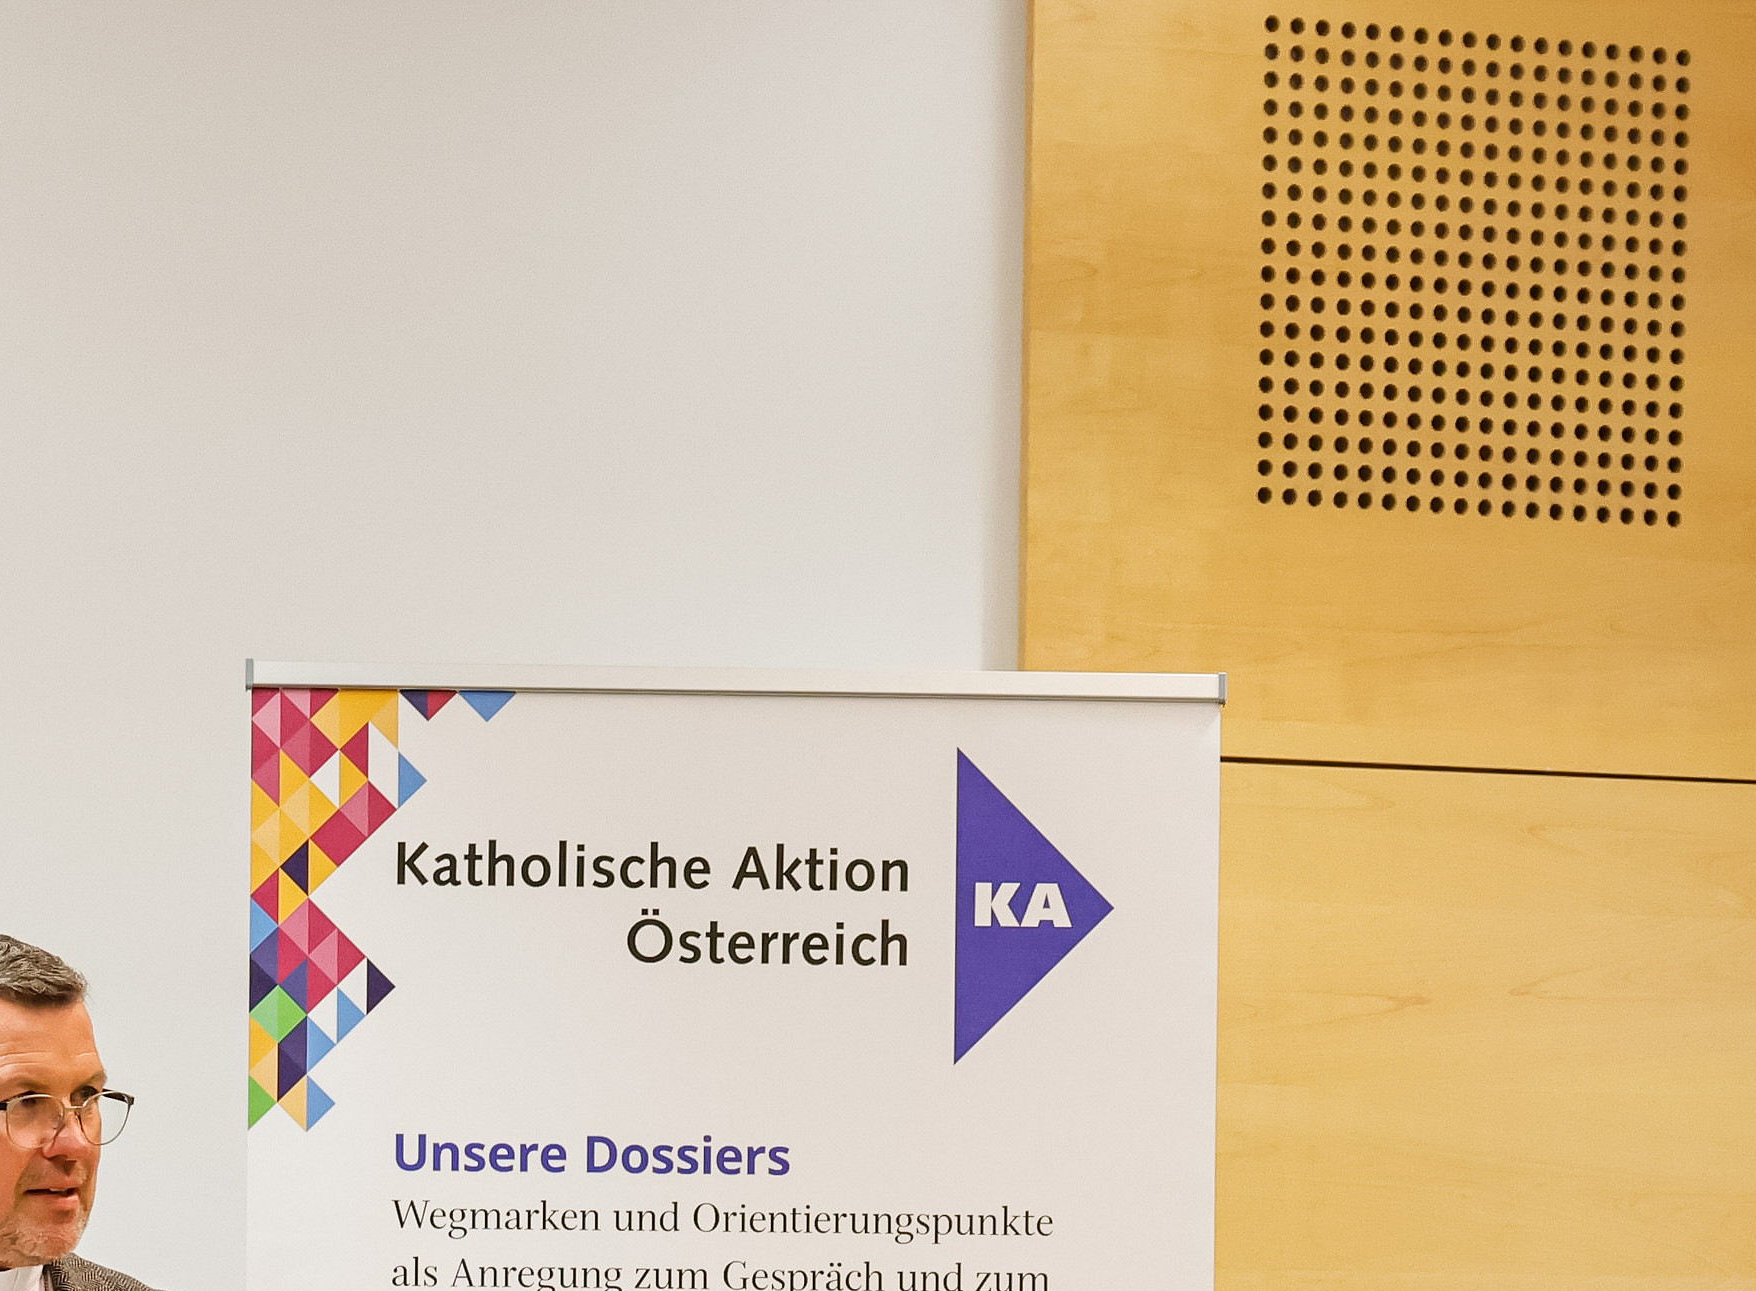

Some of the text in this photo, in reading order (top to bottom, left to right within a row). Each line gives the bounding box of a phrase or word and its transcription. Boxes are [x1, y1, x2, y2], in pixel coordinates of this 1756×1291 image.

[396, 840, 910, 892] Katholische Aktion
[973, 881, 1073, 929] KA
[626, 908, 909, 967] Österreich
[394, 1133, 791, 1176] Unsere Dossiers
[392, 1199, 1054, 1245] Wegmarken und Orientierungspunkte
[391, 1255, 438, 1287] als
[634, 1268, 709, 1290] zum
